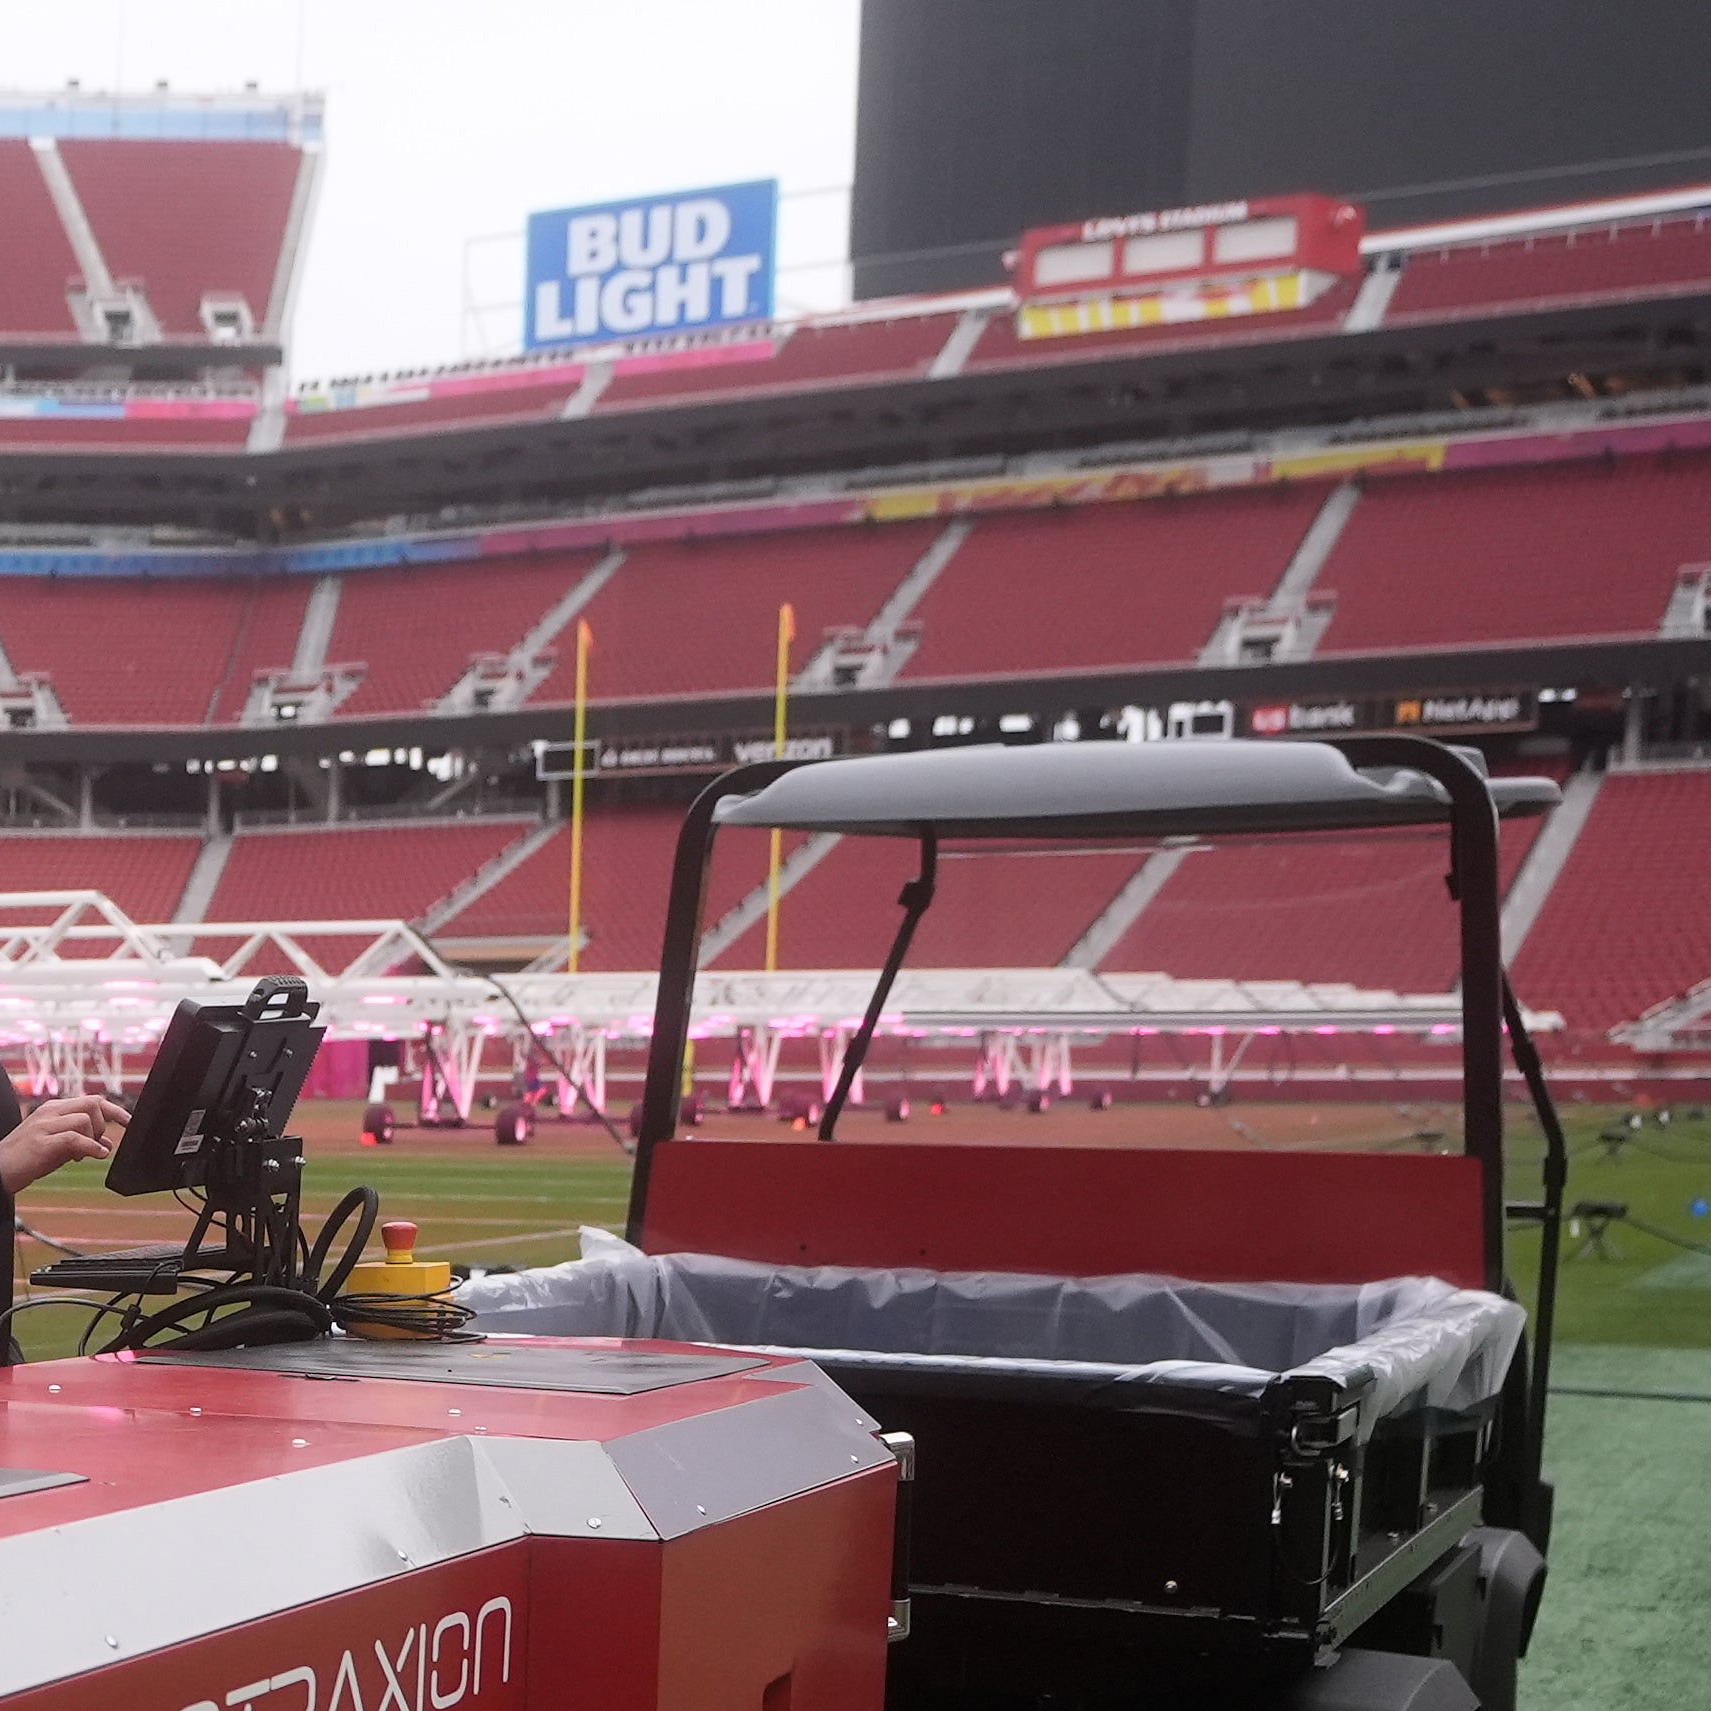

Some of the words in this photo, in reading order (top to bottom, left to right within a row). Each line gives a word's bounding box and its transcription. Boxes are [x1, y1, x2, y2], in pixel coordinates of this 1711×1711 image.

[566, 198, 732, 277] BUD
[534, 253, 762, 342] LIGHT
[1289, 703, 1356, 730] bank
[1422, 698, 1521, 724] NetApp
[734, 737, 832, 765] verzon
